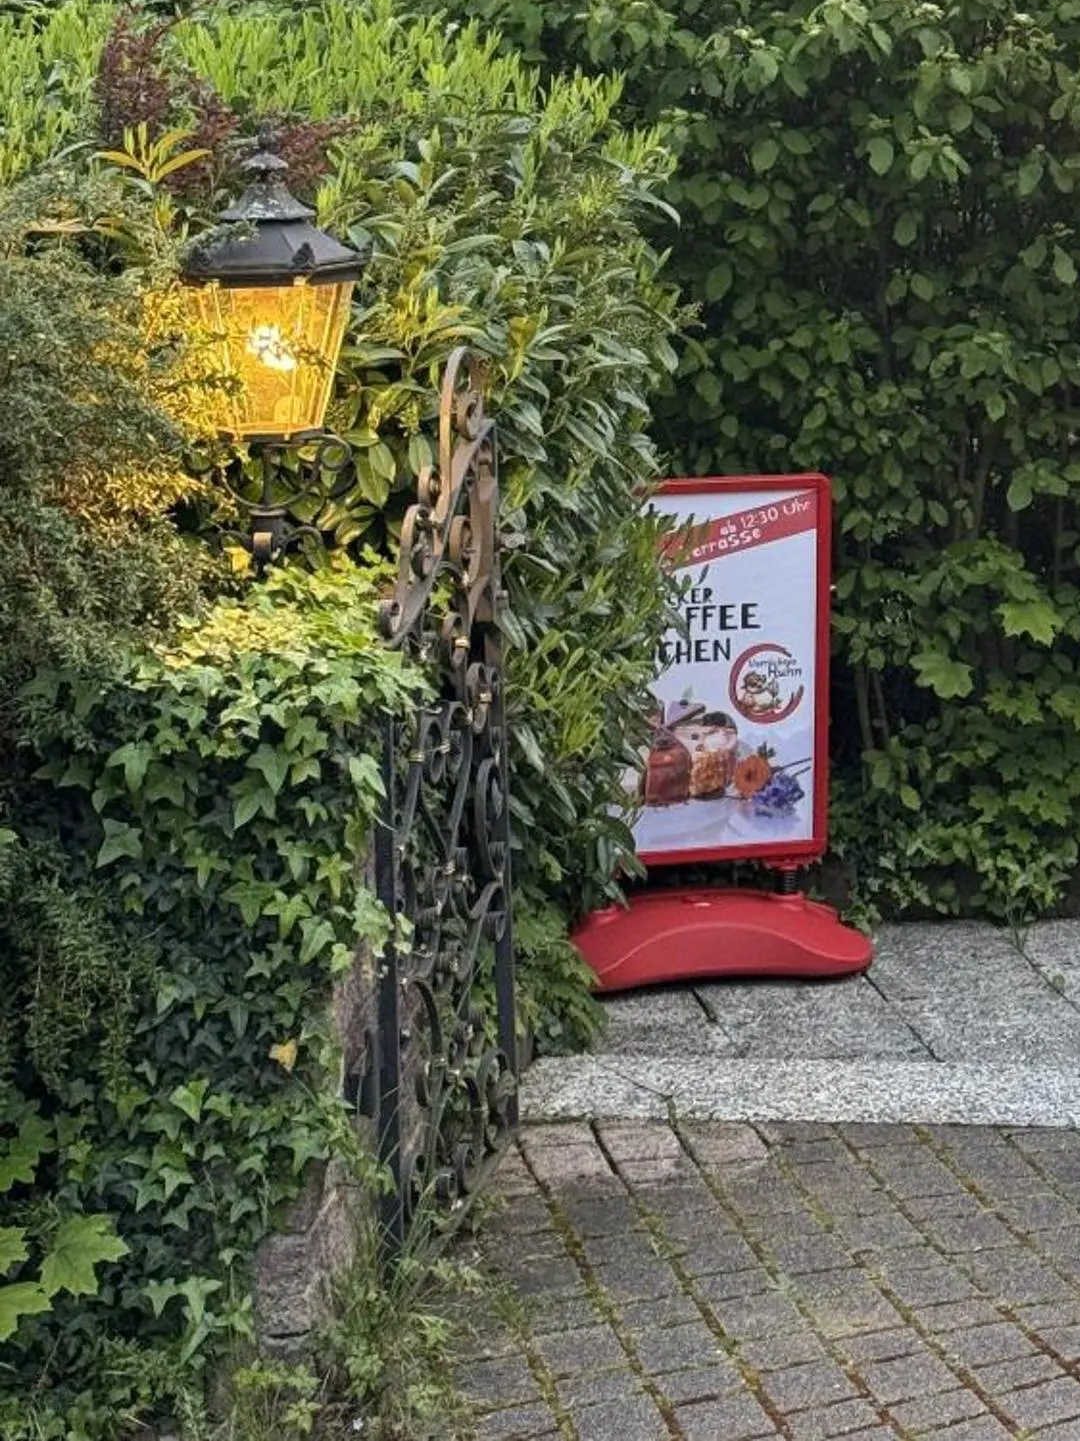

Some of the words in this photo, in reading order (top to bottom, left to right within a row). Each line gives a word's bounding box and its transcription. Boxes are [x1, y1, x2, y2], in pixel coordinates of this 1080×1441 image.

[720, 520, 737, 536] ab
[740, 507, 779, 529] 12:30
[783, 498, 811, 516] Uhr
[691, 527, 762, 558] errasse
[685, 603, 762, 631] FFEE
[658, 637, 731, 664] CHEN
